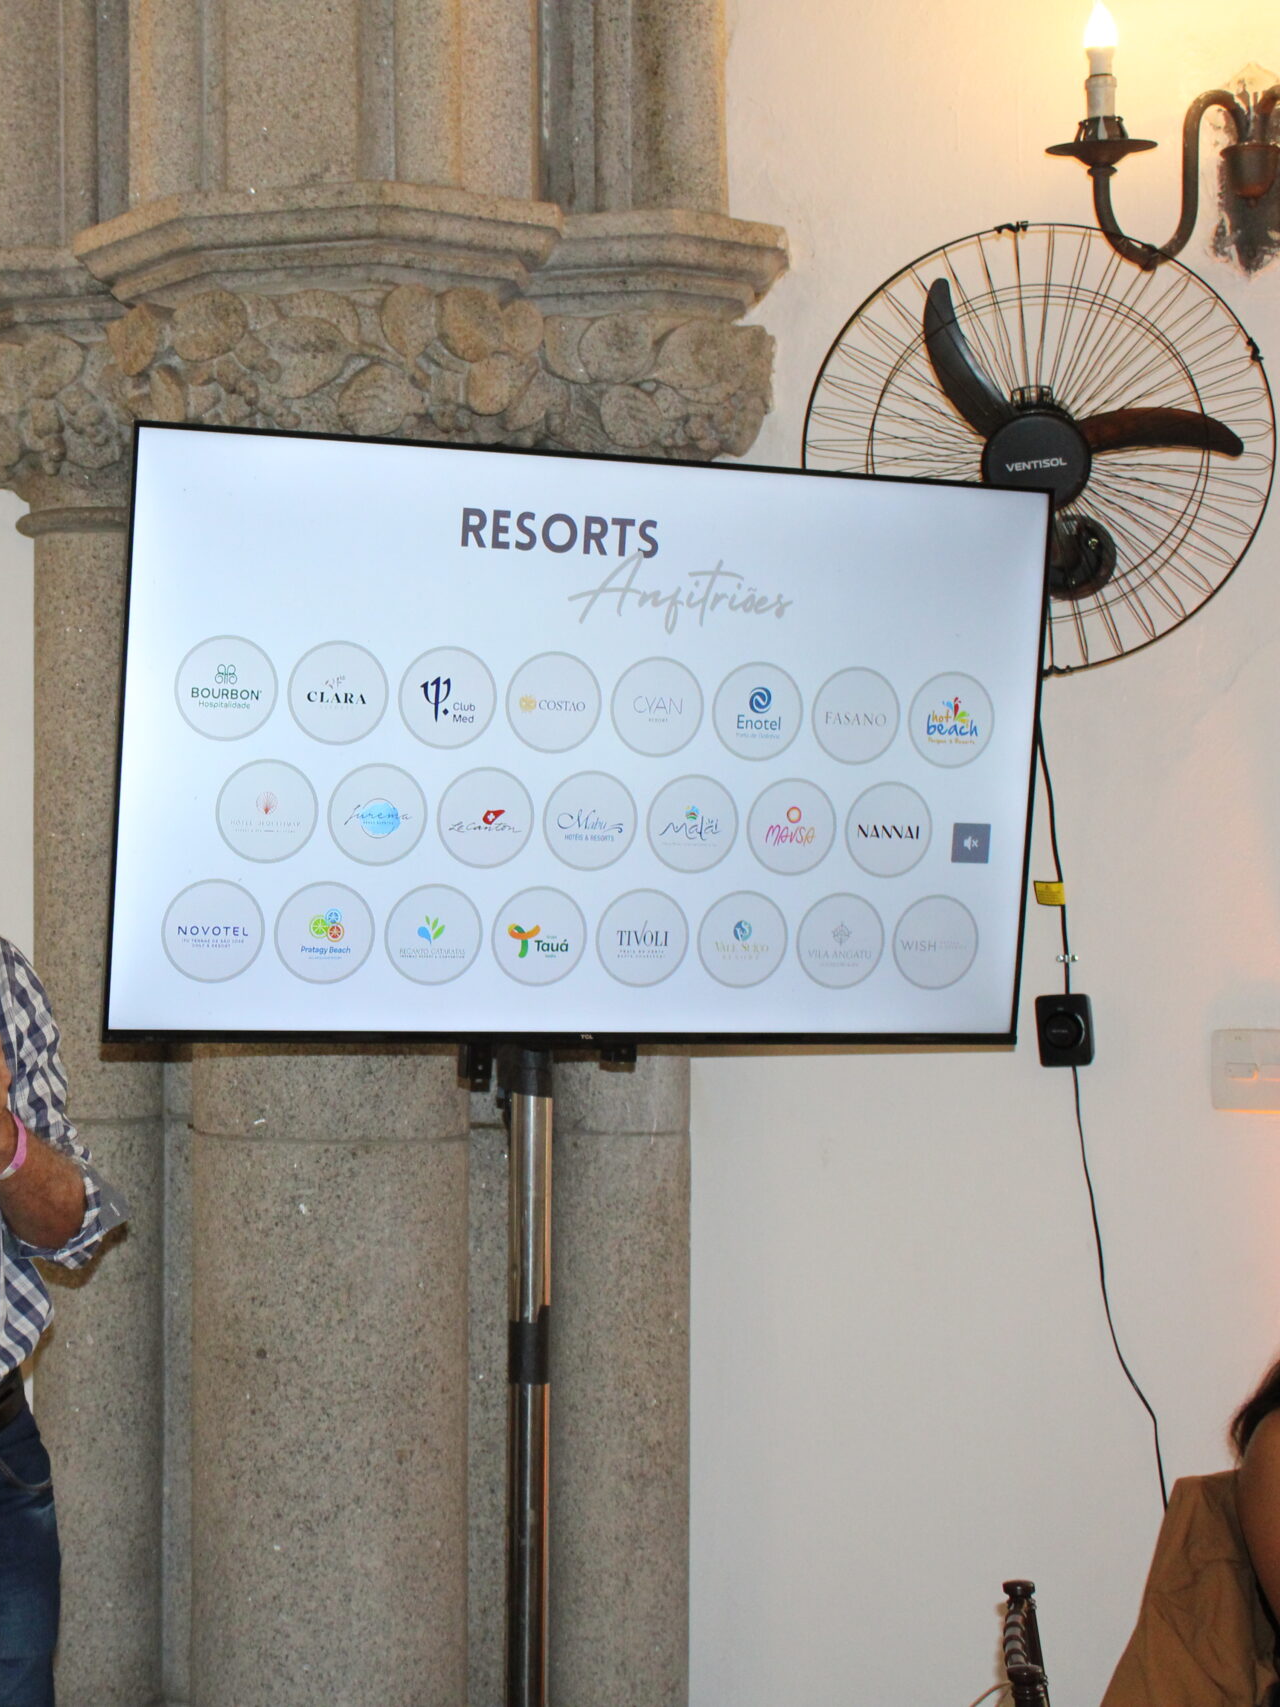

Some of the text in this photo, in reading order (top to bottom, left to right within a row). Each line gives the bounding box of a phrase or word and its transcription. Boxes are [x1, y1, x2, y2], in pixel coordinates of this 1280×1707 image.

[1005, 456, 1068, 472] VENTISOL
[461, 507, 659, 559] RESORTS
[567, 551, 794, 635] Anfitriões
[191, 687, 260, 701] BOURBON
[306, 690, 367, 705] CLARA
[198, 700, 251, 710] Hospitalidade
[453, 702, 476, 712] Club
[632, 695, 683, 715] CYAN
[453, 714, 475, 724] Med
[736, 714, 781, 731] Enotel
[825, 711, 887, 727] FASANO
[931, 709, 952, 723] hot
[926, 714, 979, 737] beach
[857, 824, 920, 840] NANNAI
[177, 925, 249, 937] NOVOTEL
[616, 920, 669, 947] TIVOLI
[300, 945, 351, 956] Pratagy Beach
[534, 939, 569, 953] Tauá
[900, 940, 937, 952] WISH
[808, 949, 873, 961] VILA ANGATU
